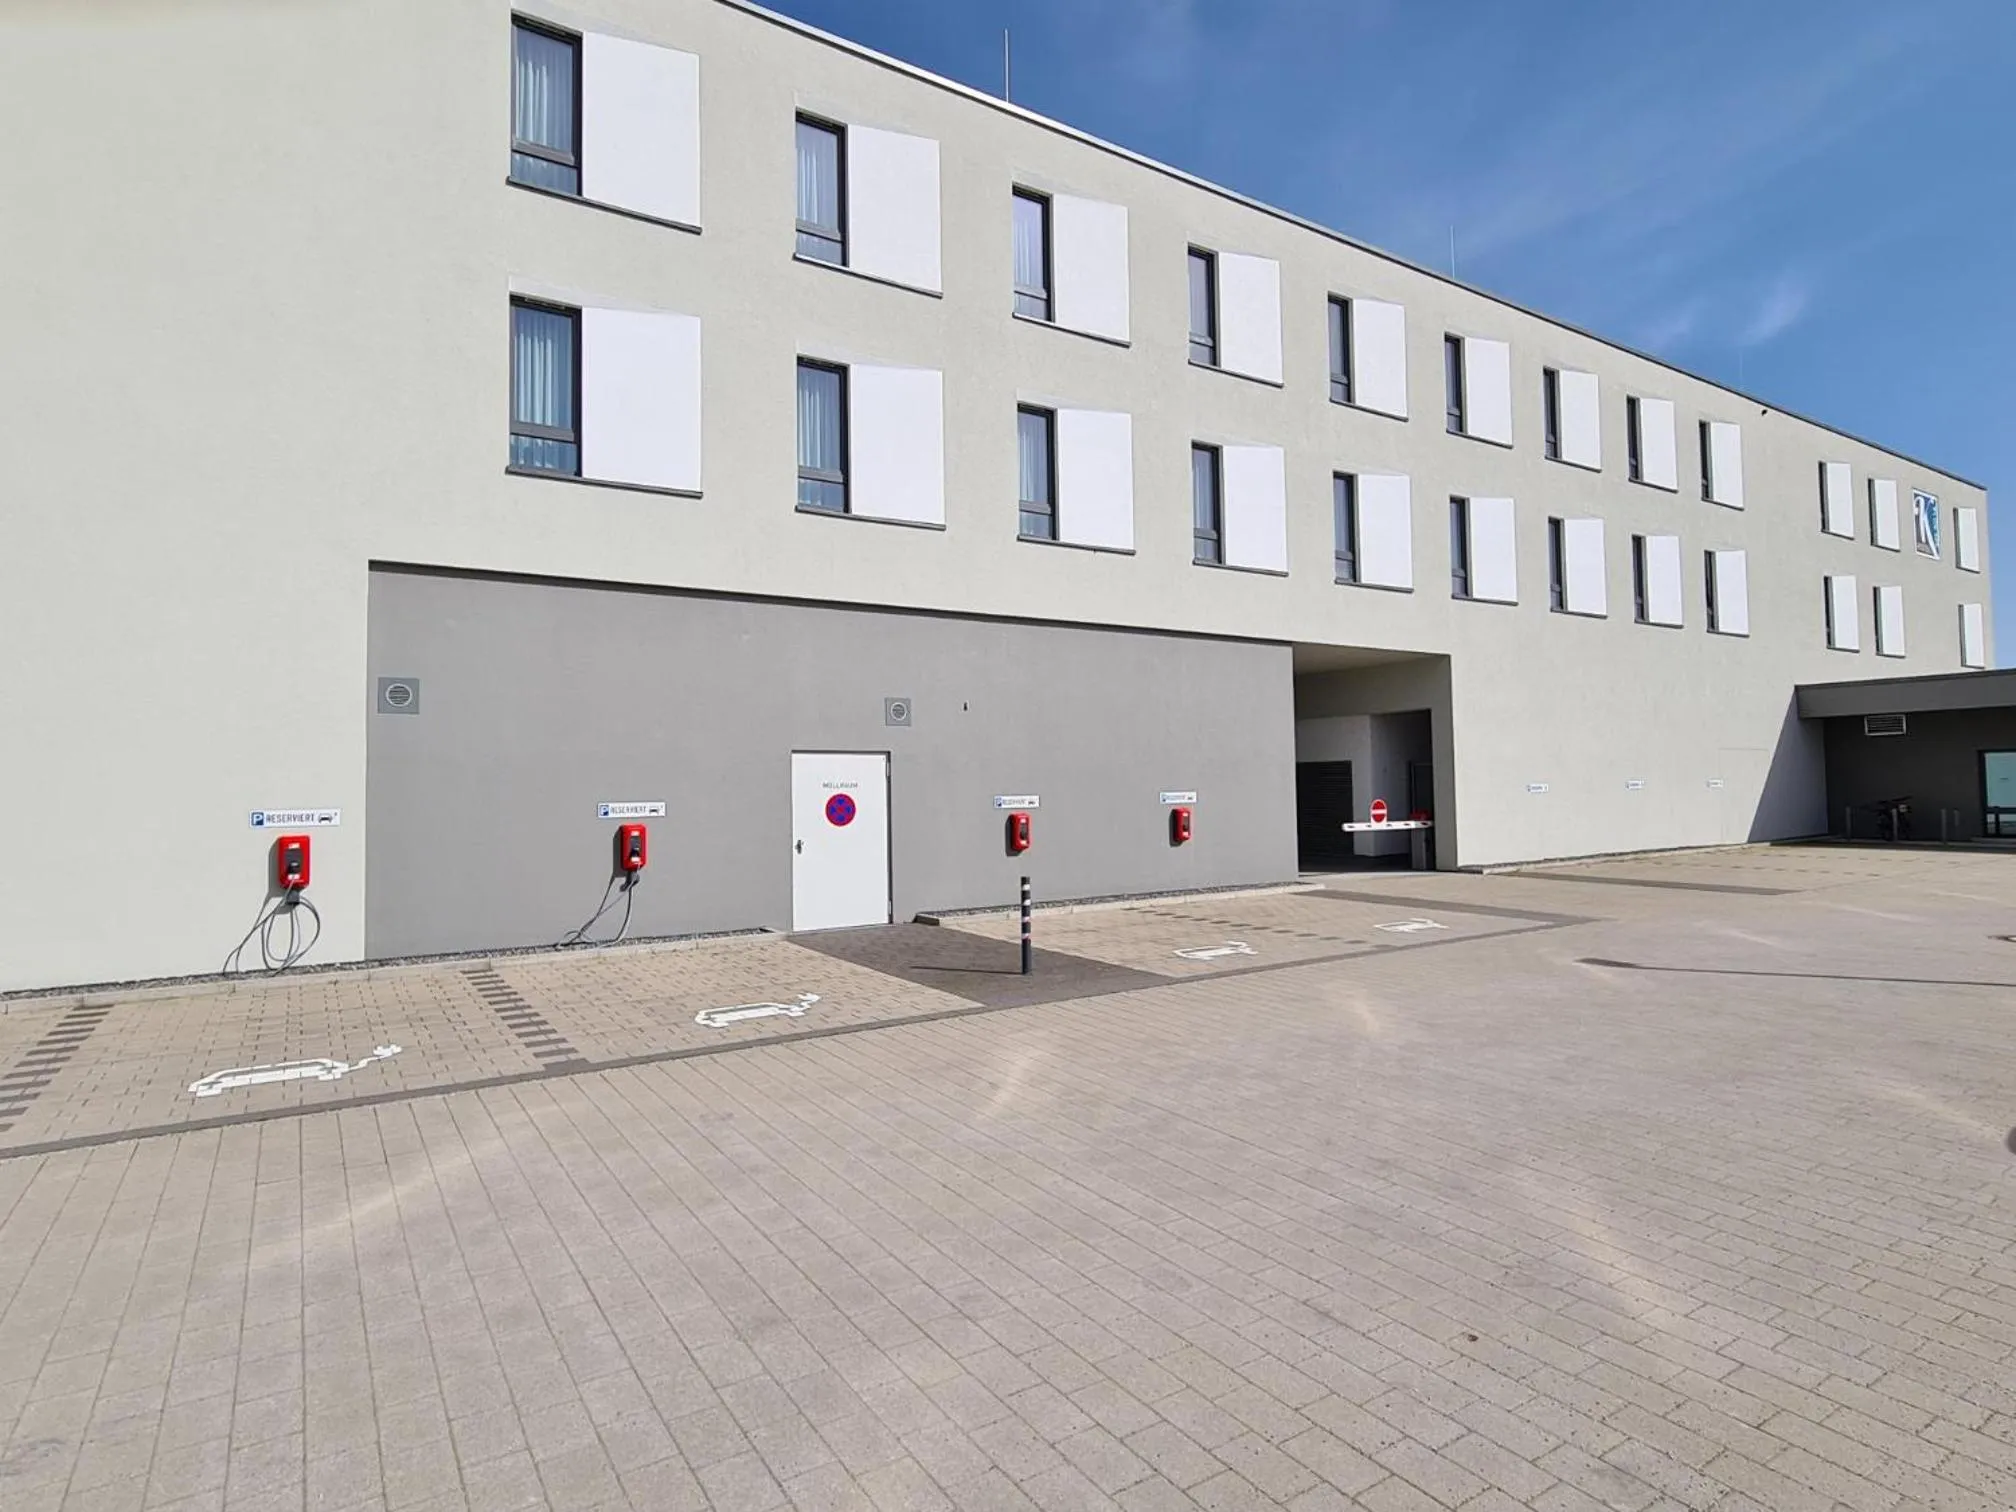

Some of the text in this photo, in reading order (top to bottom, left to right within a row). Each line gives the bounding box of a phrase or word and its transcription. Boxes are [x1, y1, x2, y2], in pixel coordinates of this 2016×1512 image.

[600, 805, 646, 816] P RESERVIERT
[252, 812, 315, 825] P RESERVIERT
